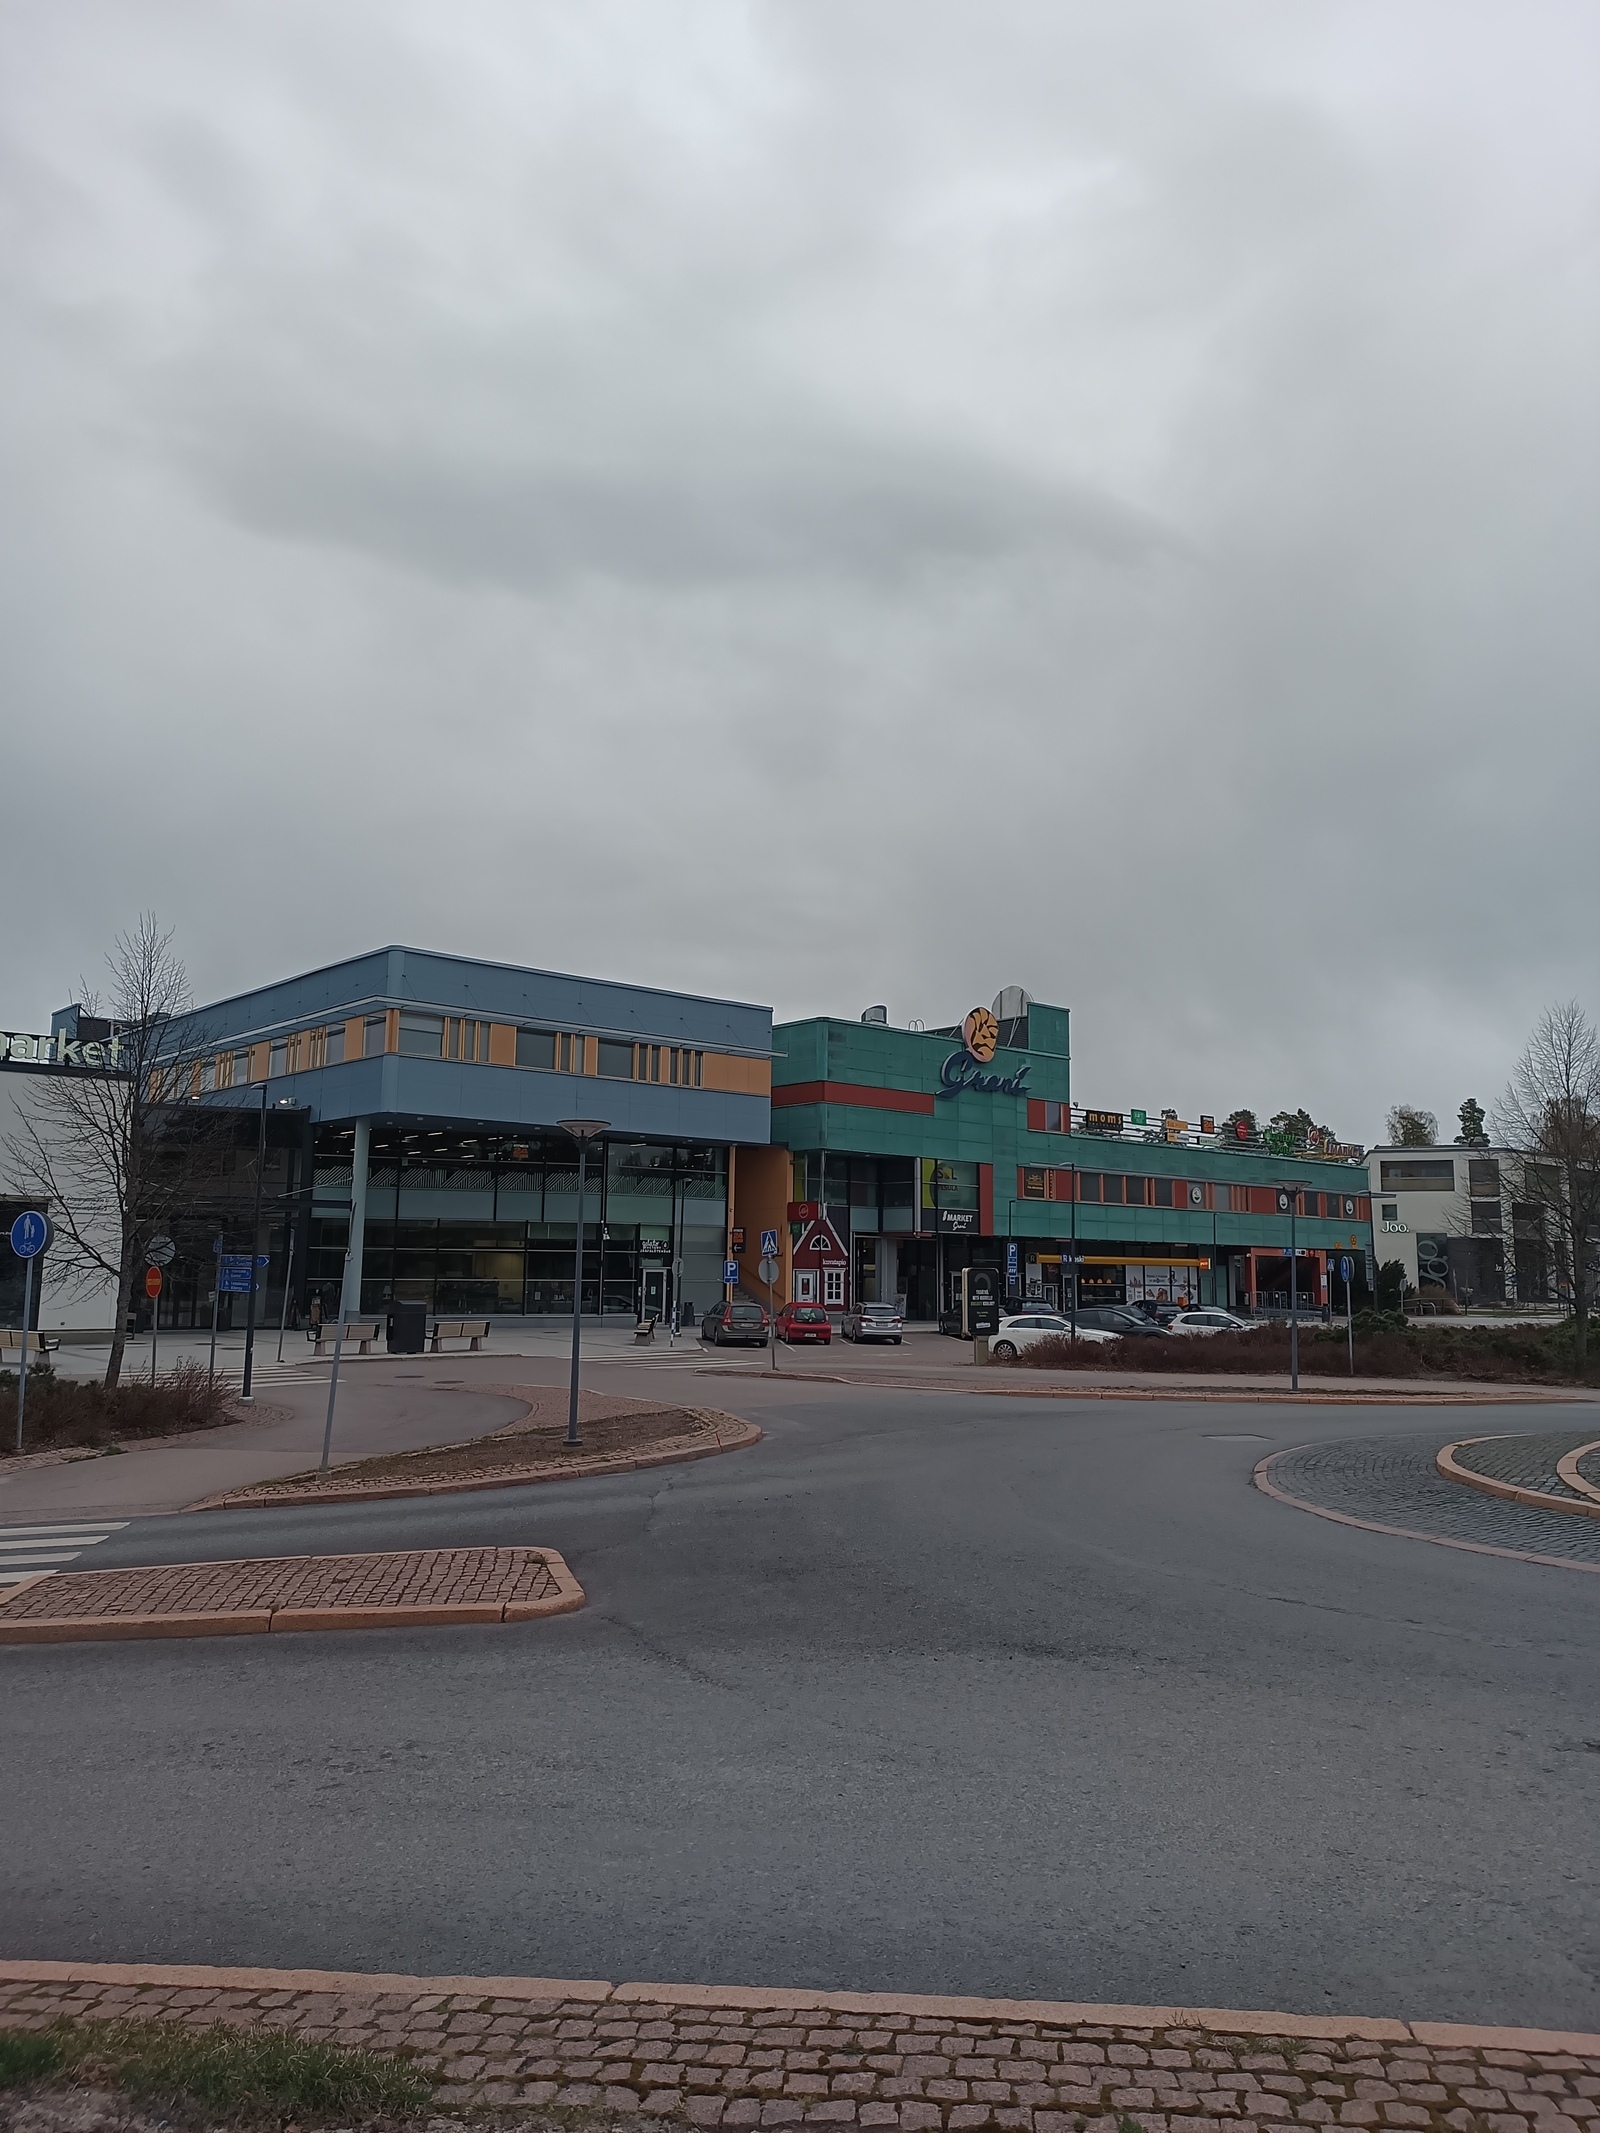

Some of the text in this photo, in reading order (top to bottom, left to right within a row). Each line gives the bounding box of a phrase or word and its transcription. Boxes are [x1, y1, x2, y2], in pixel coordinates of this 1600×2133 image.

[0, 1028, 124, 1068] arket
[1089, 1113, 1122, 1125] moms
[1382, 1220, 1410, 1233] Joo.
[727, 1262, 736, 1276] P
